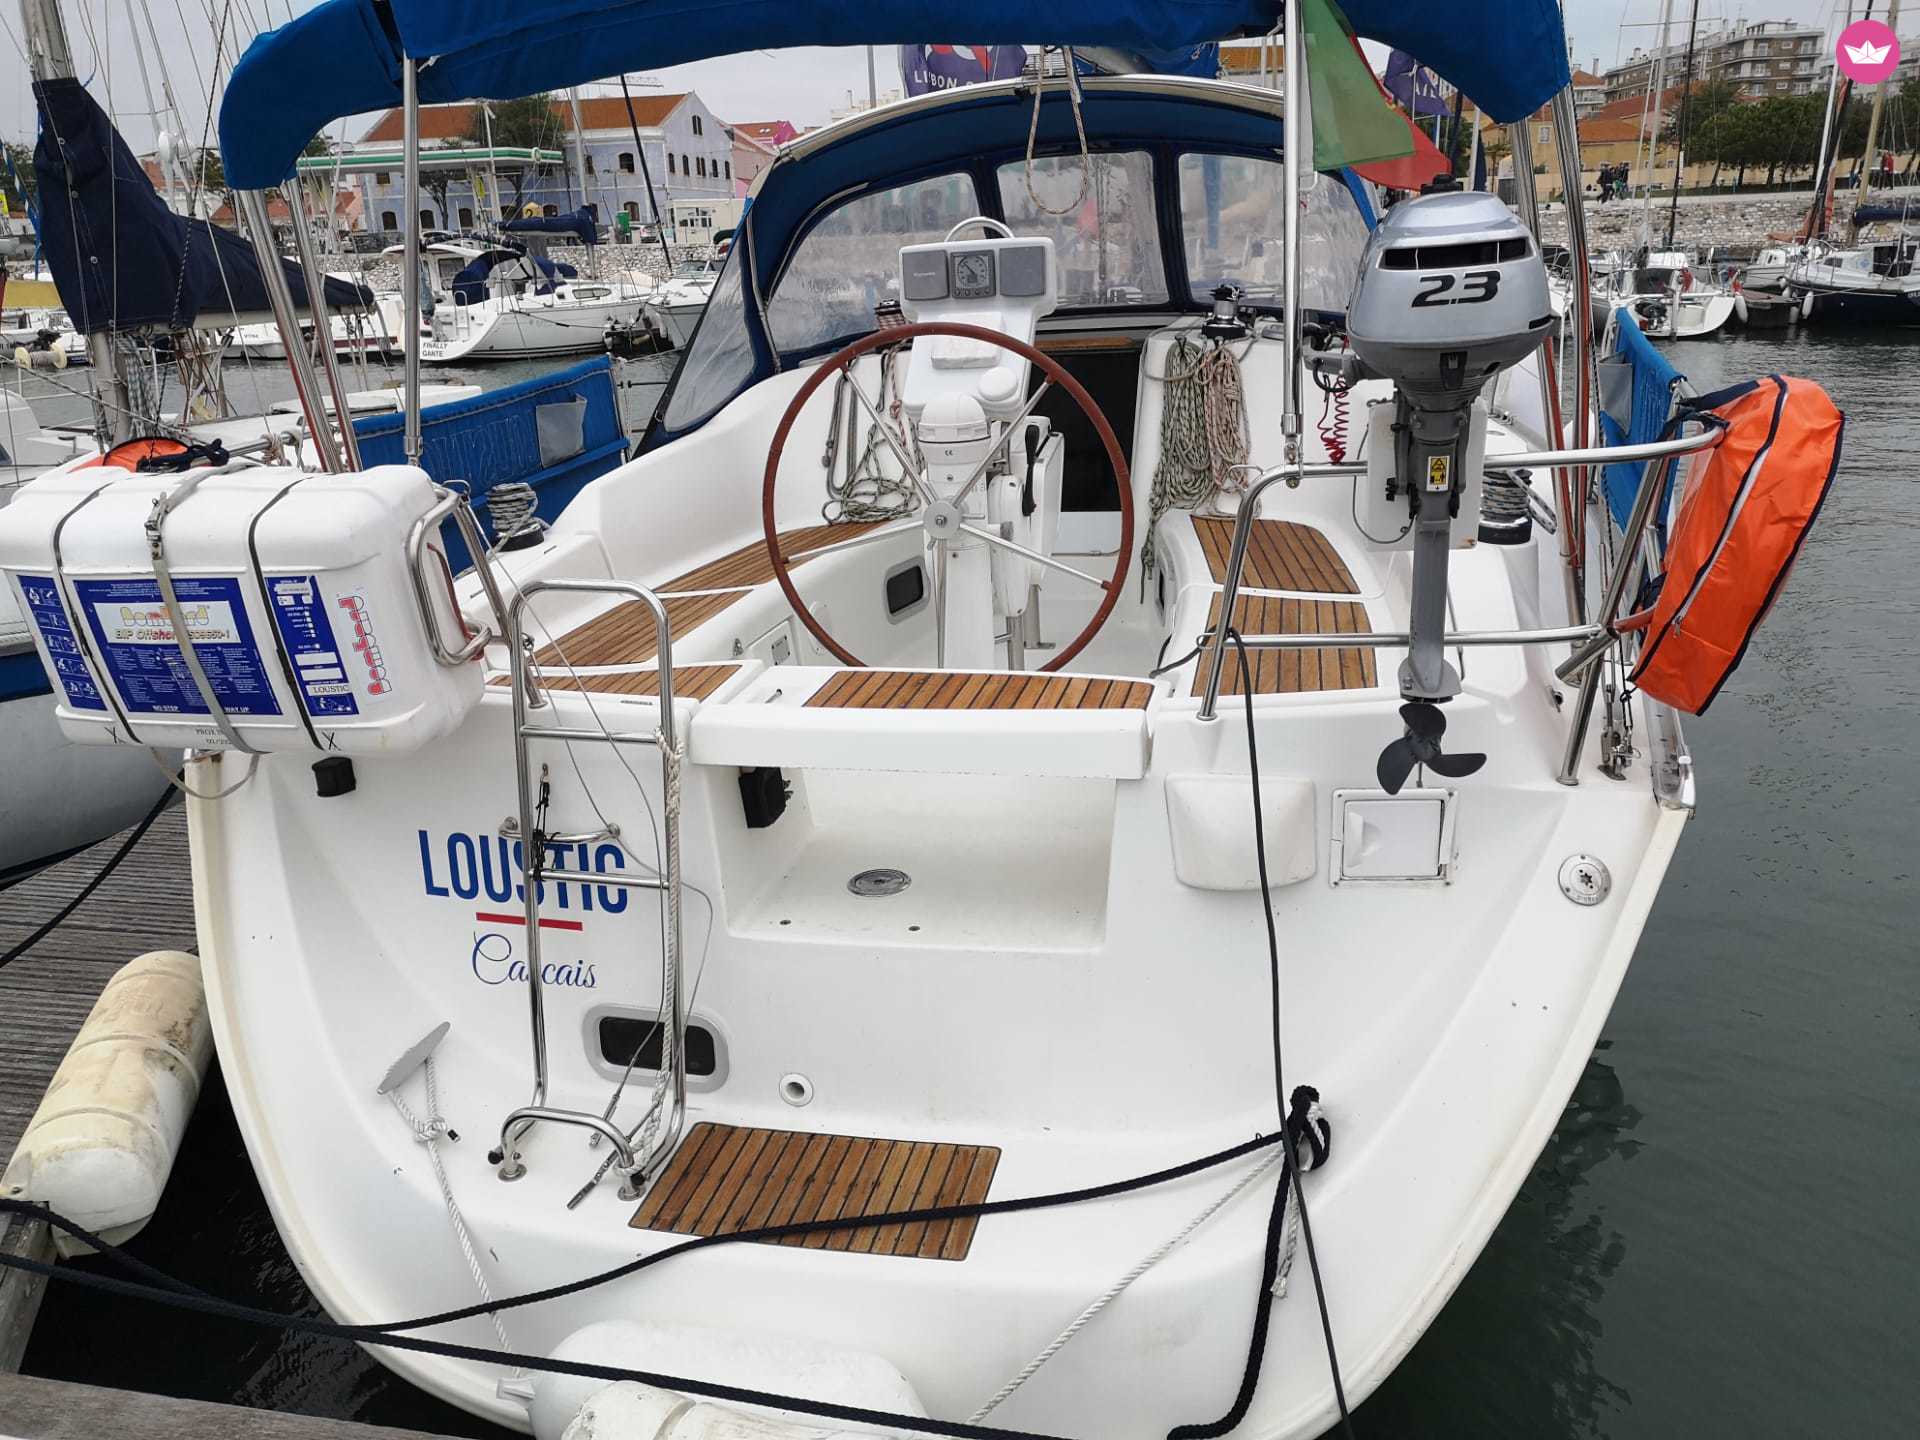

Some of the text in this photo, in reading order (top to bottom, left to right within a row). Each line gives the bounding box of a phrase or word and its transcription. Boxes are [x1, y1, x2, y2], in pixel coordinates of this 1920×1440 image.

[1411, 270, 1501, 308] 2.3
[422, 342, 448, 350] FINALLY
[472, 930, 599, 990] Cacais
